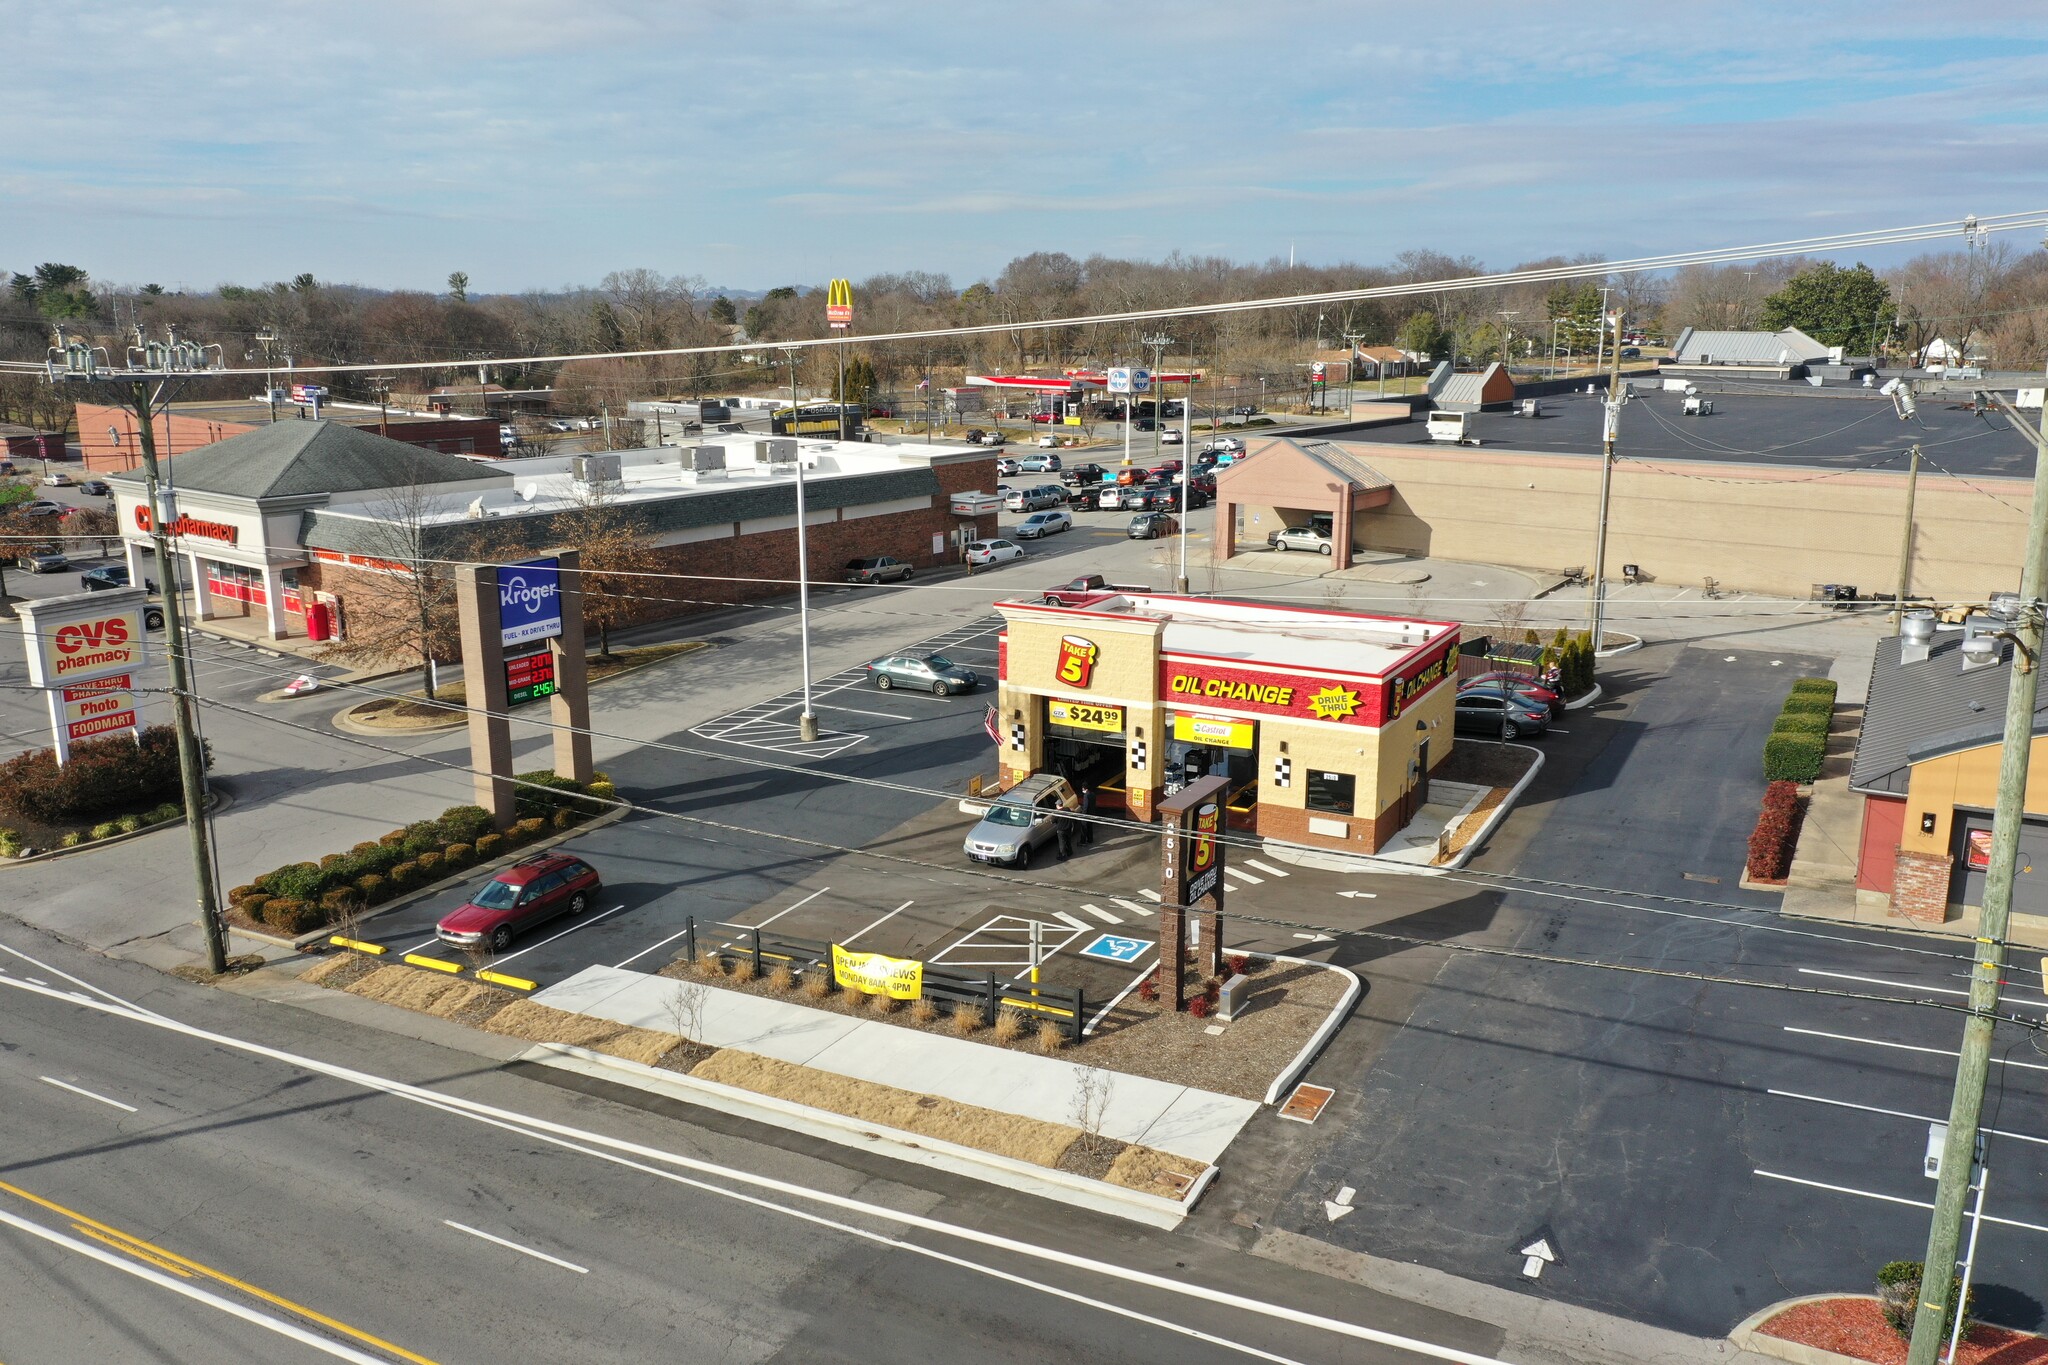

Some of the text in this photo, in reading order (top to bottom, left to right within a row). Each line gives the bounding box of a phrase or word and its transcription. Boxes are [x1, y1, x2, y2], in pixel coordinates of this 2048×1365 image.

[175, 513, 239, 549] pharmacy
[501, 576, 557, 614] Kroger
[55, 618, 129, 654] CVS
[504, 631, 518, 640] FUEL
[522, 629, 530, 637] RX
[530, 625, 546, 634] DRIVE
[546, 622, 560, 631] THRU
[57, 648, 131, 674] pharmacy
[1063, 642, 1087, 657] TAKE
[1060, 656, 1082, 682] 5
[1171, 675, 1293, 705] OIL CHANGE
[1318, 695, 1348, 705] DRIVE
[80, 699, 119, 716] Photo
[1321, 703, 1348, 712] THRU
[72, 713, 132, 736] FOODMART
[1201, 725, 1227, 735] Castrol
[1199, 815, 1213, 830] TAKE
[1196, 834, 1210, 866] 5
[1190, 865, 1217, 894] DRIVE THRU
[1197, 874, 1217, 897] CHANGE
[835, 954, 856, 968] OPEN
[839, 970, 868, 985] MONDAY
[869, 978, 886, 989] 8AM
[892, 982, 911, 992] 4PM
